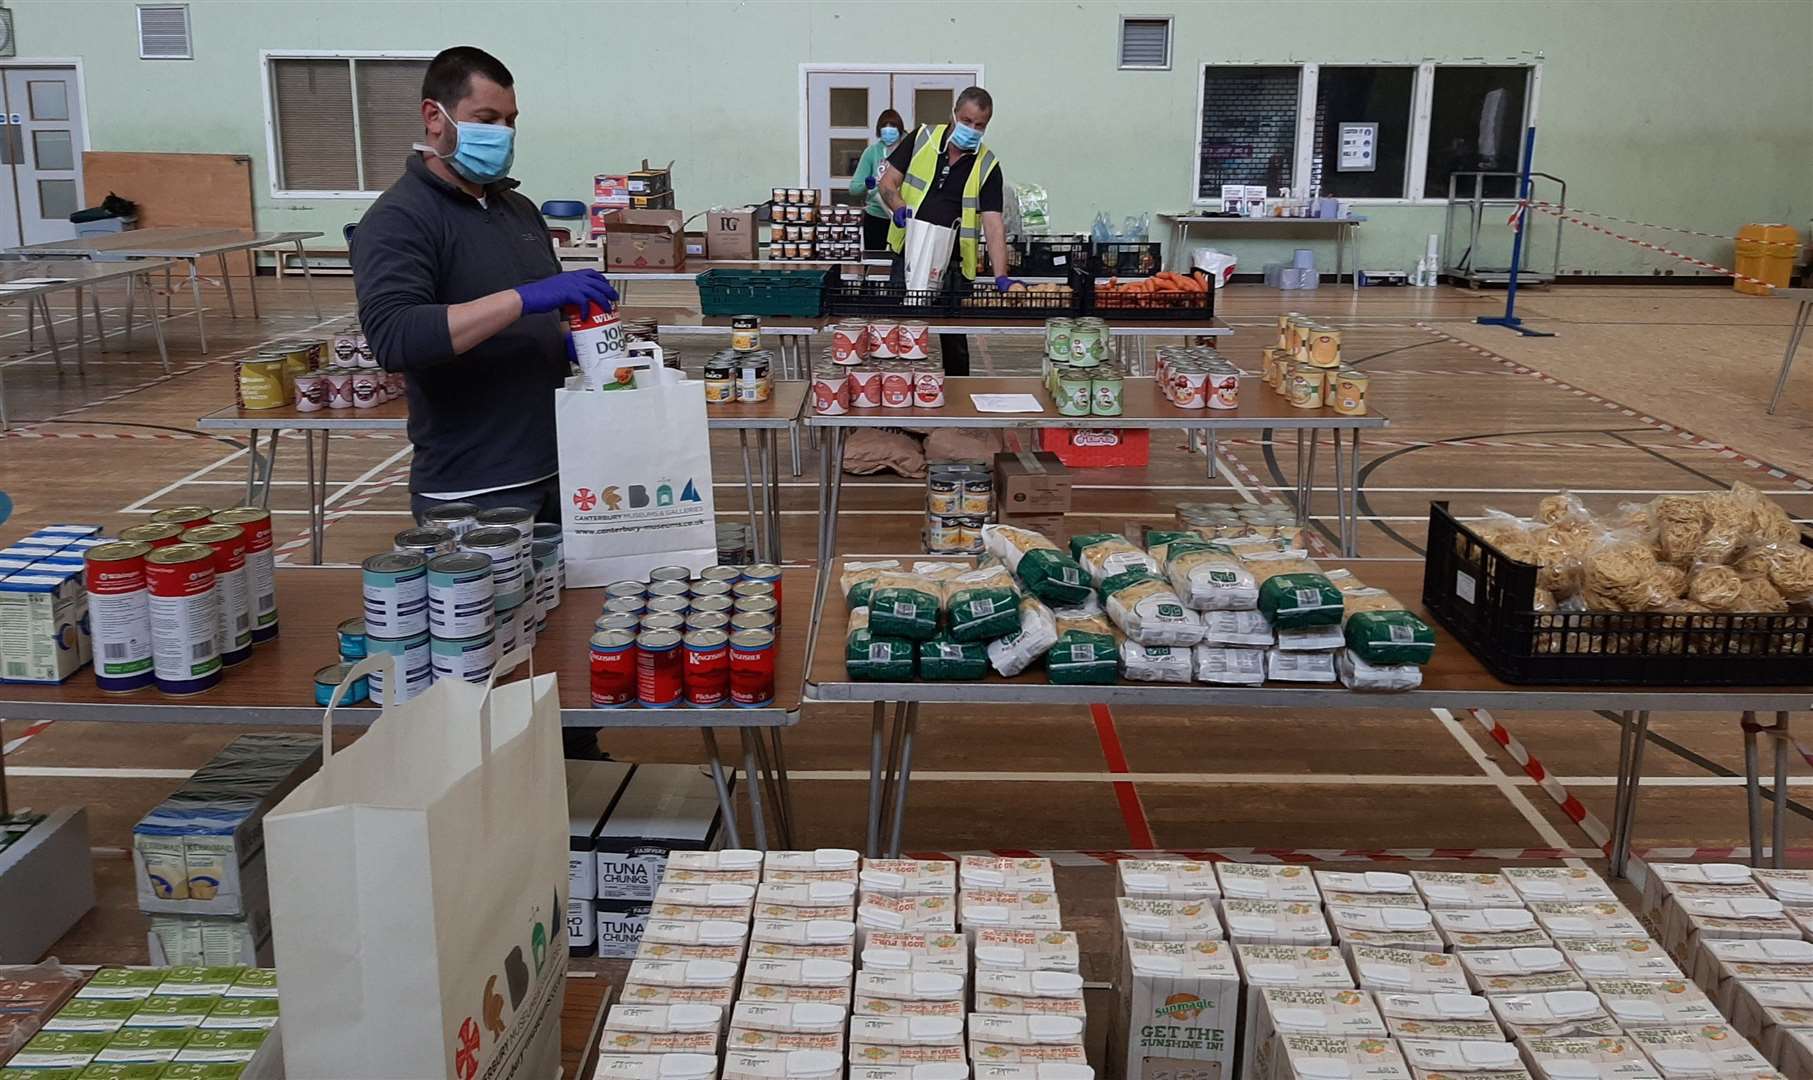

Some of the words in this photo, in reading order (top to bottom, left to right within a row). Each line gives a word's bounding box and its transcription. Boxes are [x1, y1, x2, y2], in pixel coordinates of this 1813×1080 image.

[596, 340, 626, 354] Dog
[574, 518, 704, 535] www.canterbury-museums.co.uk
[603, 862, 647, 875] TUNA
[603, 874, 649, 884] CHUNKS
[602, 921, 645, 934] TUNA
[602, 933, 642, 943] CHUNK
[1141, 1026, 1180, 1038] GET
[1185, 1028, 1224, 1041] THE
[1140, 1039, 1203, 1049] SUNSHINE
[1206, 1041, 1224, 1051] IN!
